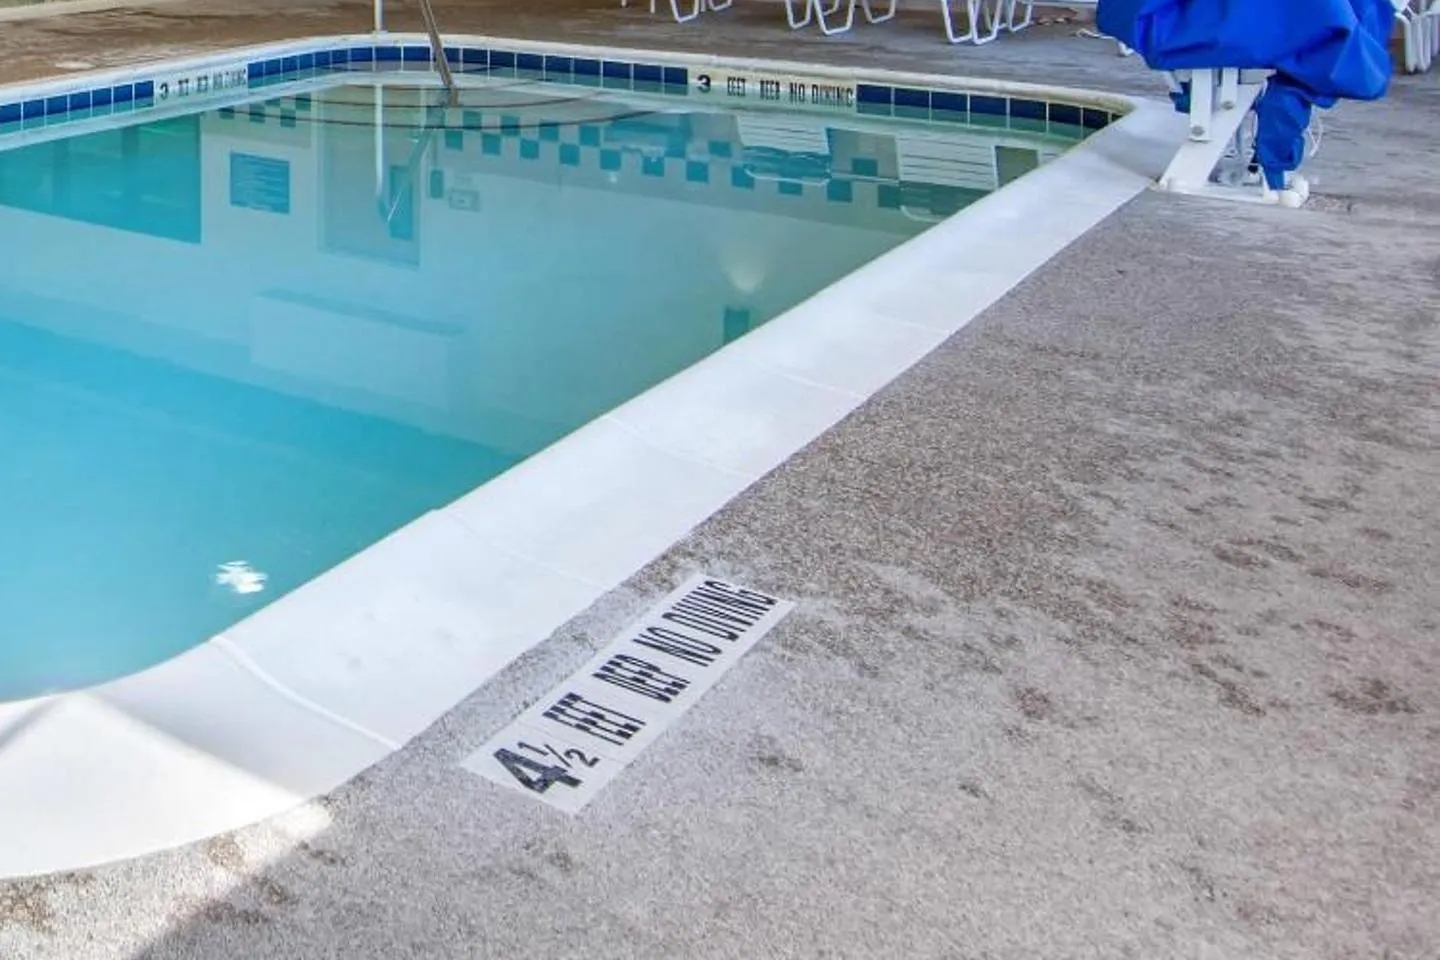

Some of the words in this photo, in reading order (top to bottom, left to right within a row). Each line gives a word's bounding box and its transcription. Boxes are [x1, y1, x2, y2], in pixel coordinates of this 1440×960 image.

[662, 580, 779, 642] DIVING
[632, 625, 723, 668] NO
[592, 653, 692, 704] DEEP
[542, 692, 647, 747] FEET
